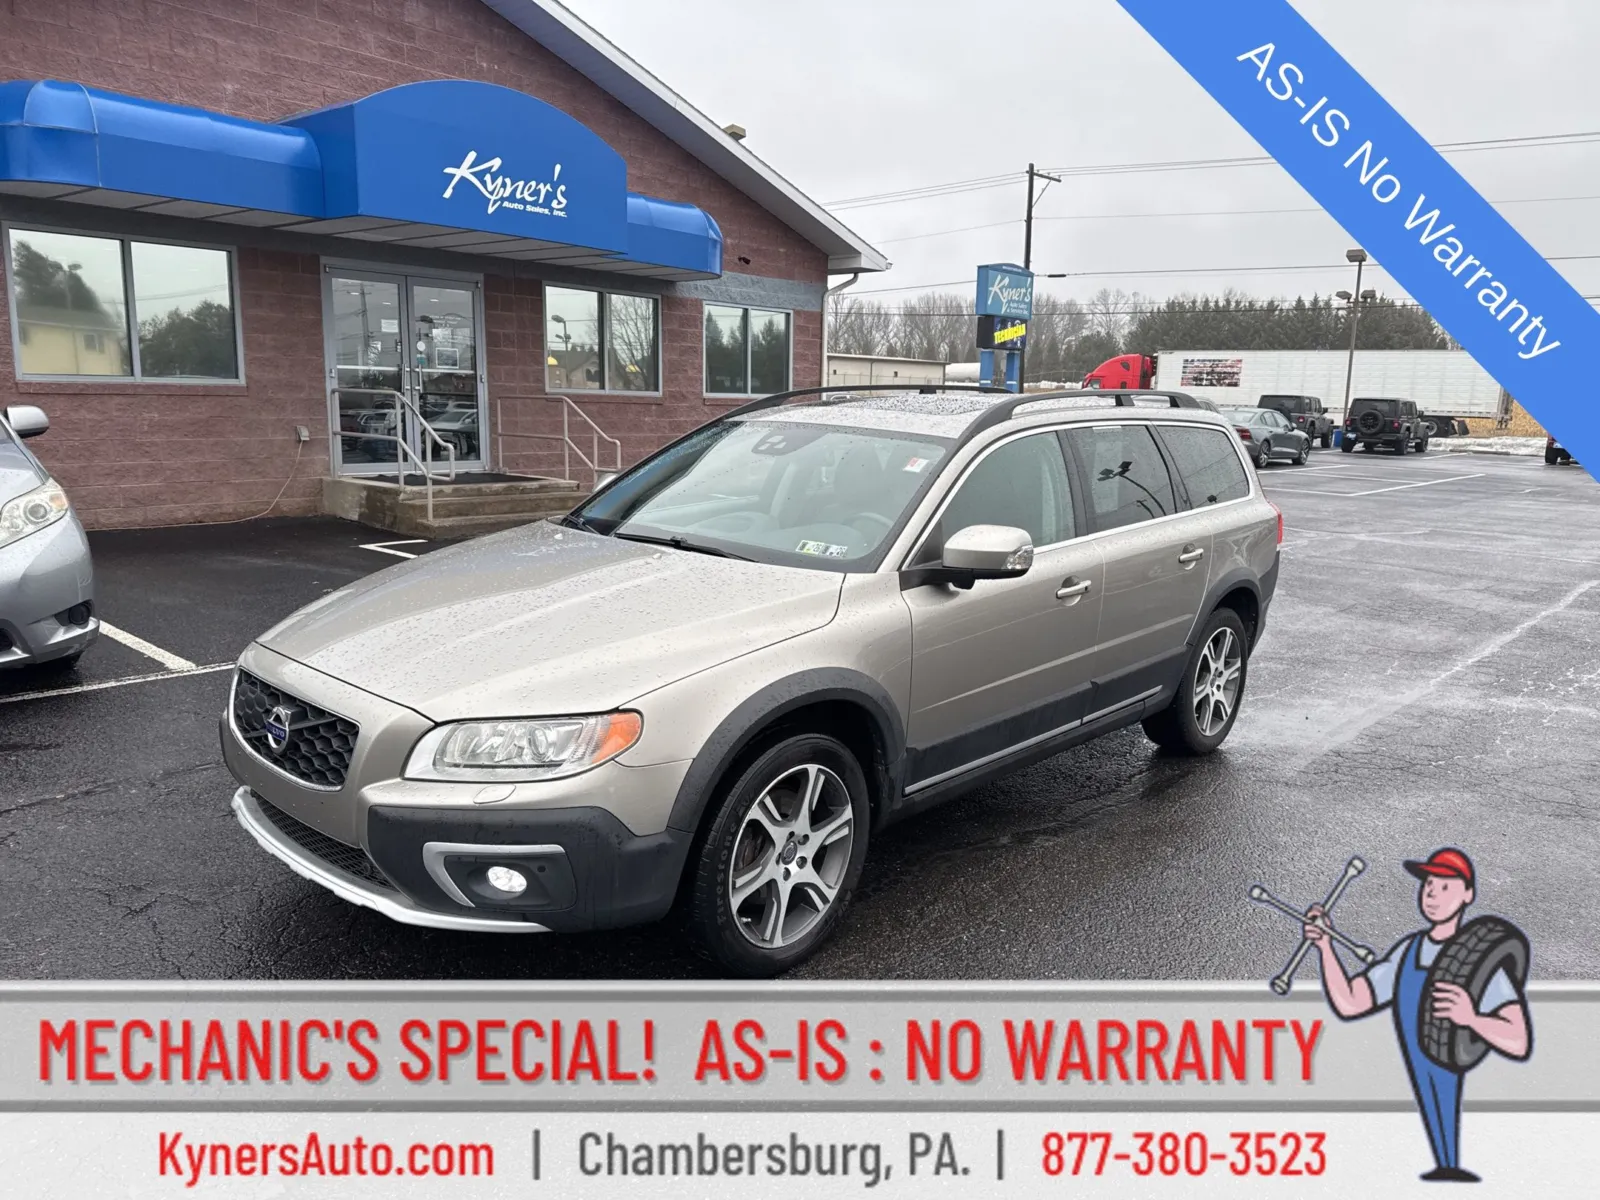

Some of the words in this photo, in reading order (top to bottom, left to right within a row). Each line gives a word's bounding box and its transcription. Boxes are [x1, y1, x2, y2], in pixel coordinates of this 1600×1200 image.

[442, 150, 568, 215] Kyner's
[502, 201, 525, 211] Auto
[525, 204, 551, 215] Sales,
[988, 274, 1031, 314] Kyner's
[266, 722, 285, 738] LVO
